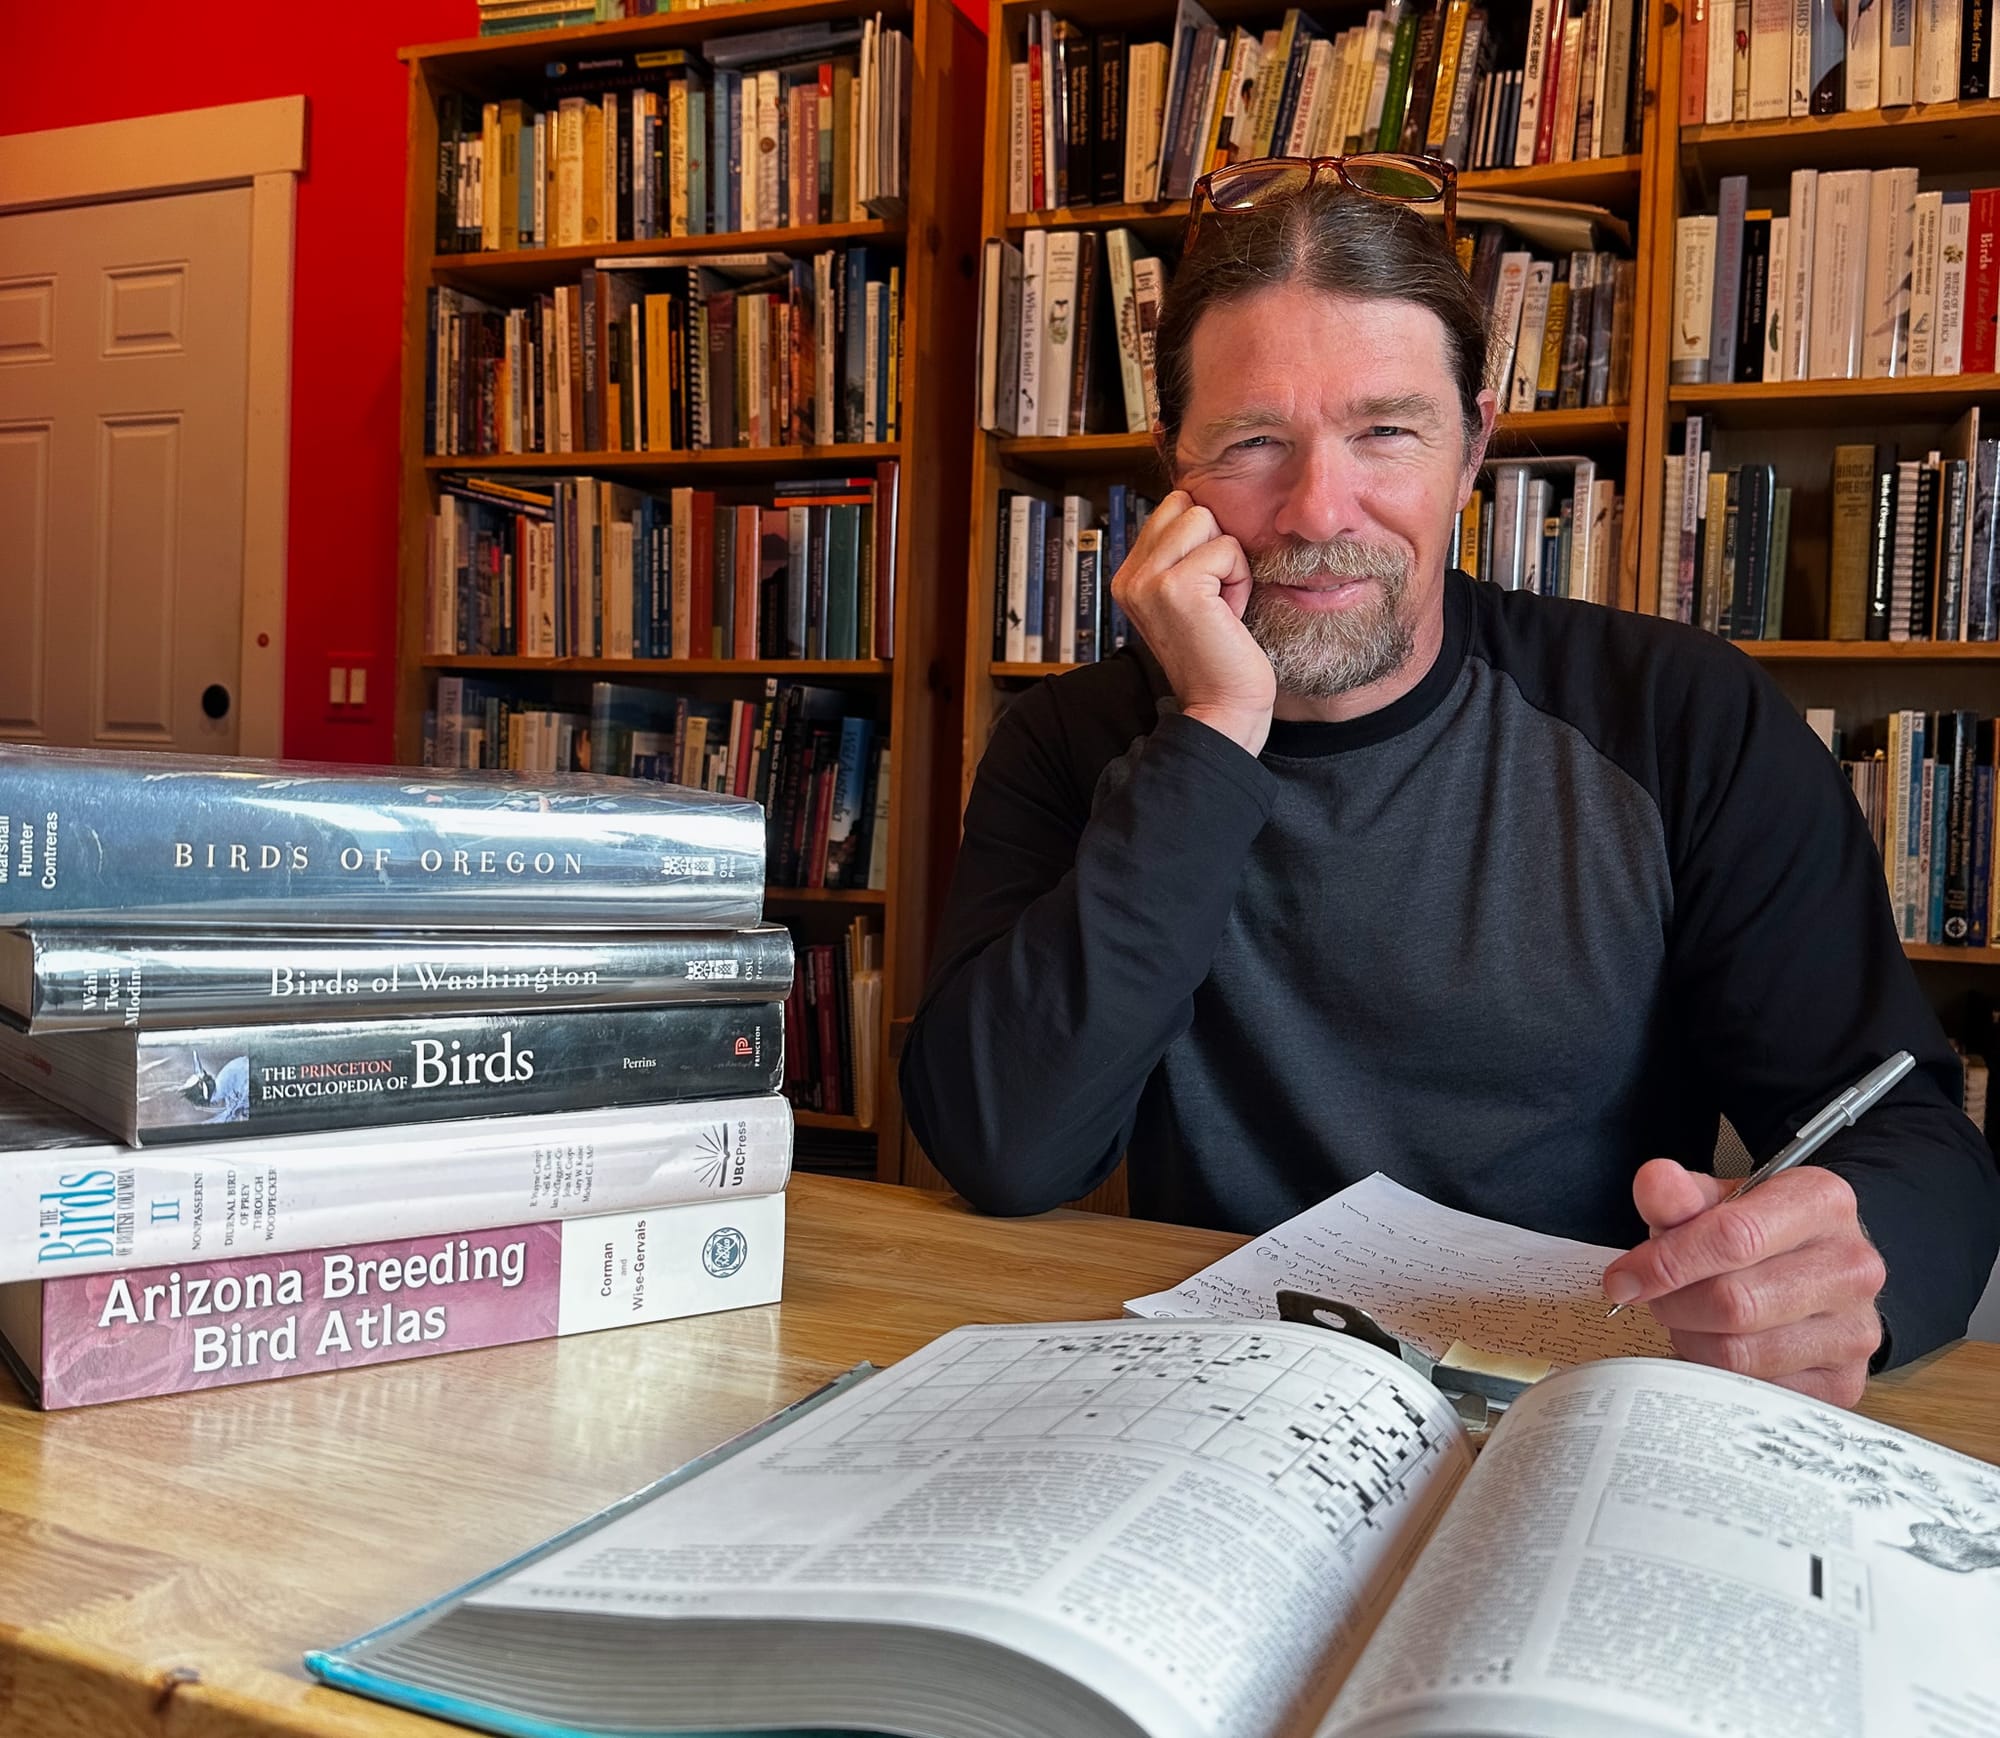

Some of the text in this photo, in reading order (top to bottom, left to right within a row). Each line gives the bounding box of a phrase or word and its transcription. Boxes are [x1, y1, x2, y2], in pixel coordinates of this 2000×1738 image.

[1531, 8, 1545, 49] WHOSE
[1031, 80, 1042, 110] BIRD
[1447, 30, 1480, 137] What Birds Eat
[1684, 245, 1696, 273] Birds
[1979, 233, 1993, 270] Birds
[1023, 291, 1036, 324] What
[583, 301, 596, 392] Natural Kansas
[1024, 328, 1036, 338] Is
[1022, 351, 1035, 383] Bird?
[1050, 538, 1061, 581] Corvus
[1080, 556, 1094, 616] Warblers
[1900, 714, 1910, 753] SONOMA
[771, 743, 781, 771] WILD
[1898, 754, 1908, 792] COUNTY
[18, 822, 34, 877] Hunter
[41, 811, 58, 889] Contreras
[174, 842, 583, 875] BIRDS OF OREGON
[719, 855, 728, 878] OSU
[269, 962, 599, 997] Birds of Washington
[745, 957, 754, 981] OSU
[82, 969, 98, 1011] Wahl
[262, 1060, 392, 1082] THE PRINCETON
[411, 1032, 534, 1088] Birds
[623, 1057, 656, 1069] Perrins
[262, 1076, 408, 1100] ENCYCLOPEDIA OF
[732, 1121, 747, 1186] UBCPress
[38, 1170, 116, 1264] Birds
[40, 1208, 59, 1228] THE
[151, 1200, 180, 1224] II
[225, 1170, 237, 1247] DIURNAL BIRD
[241, 1183, 250, 1226] OF PREY
[253, 1176, 264, 1232] THROUGH
[99, 1240, 527, 1328] Arizona Breeding
[600, 1242, 614, 1297] Corman
[620, 1258, 628, 1277] and
[632, 1219, 647, 1311] Wise-Gervais
[193, 1303, 446, 1373] Bird Atlas
